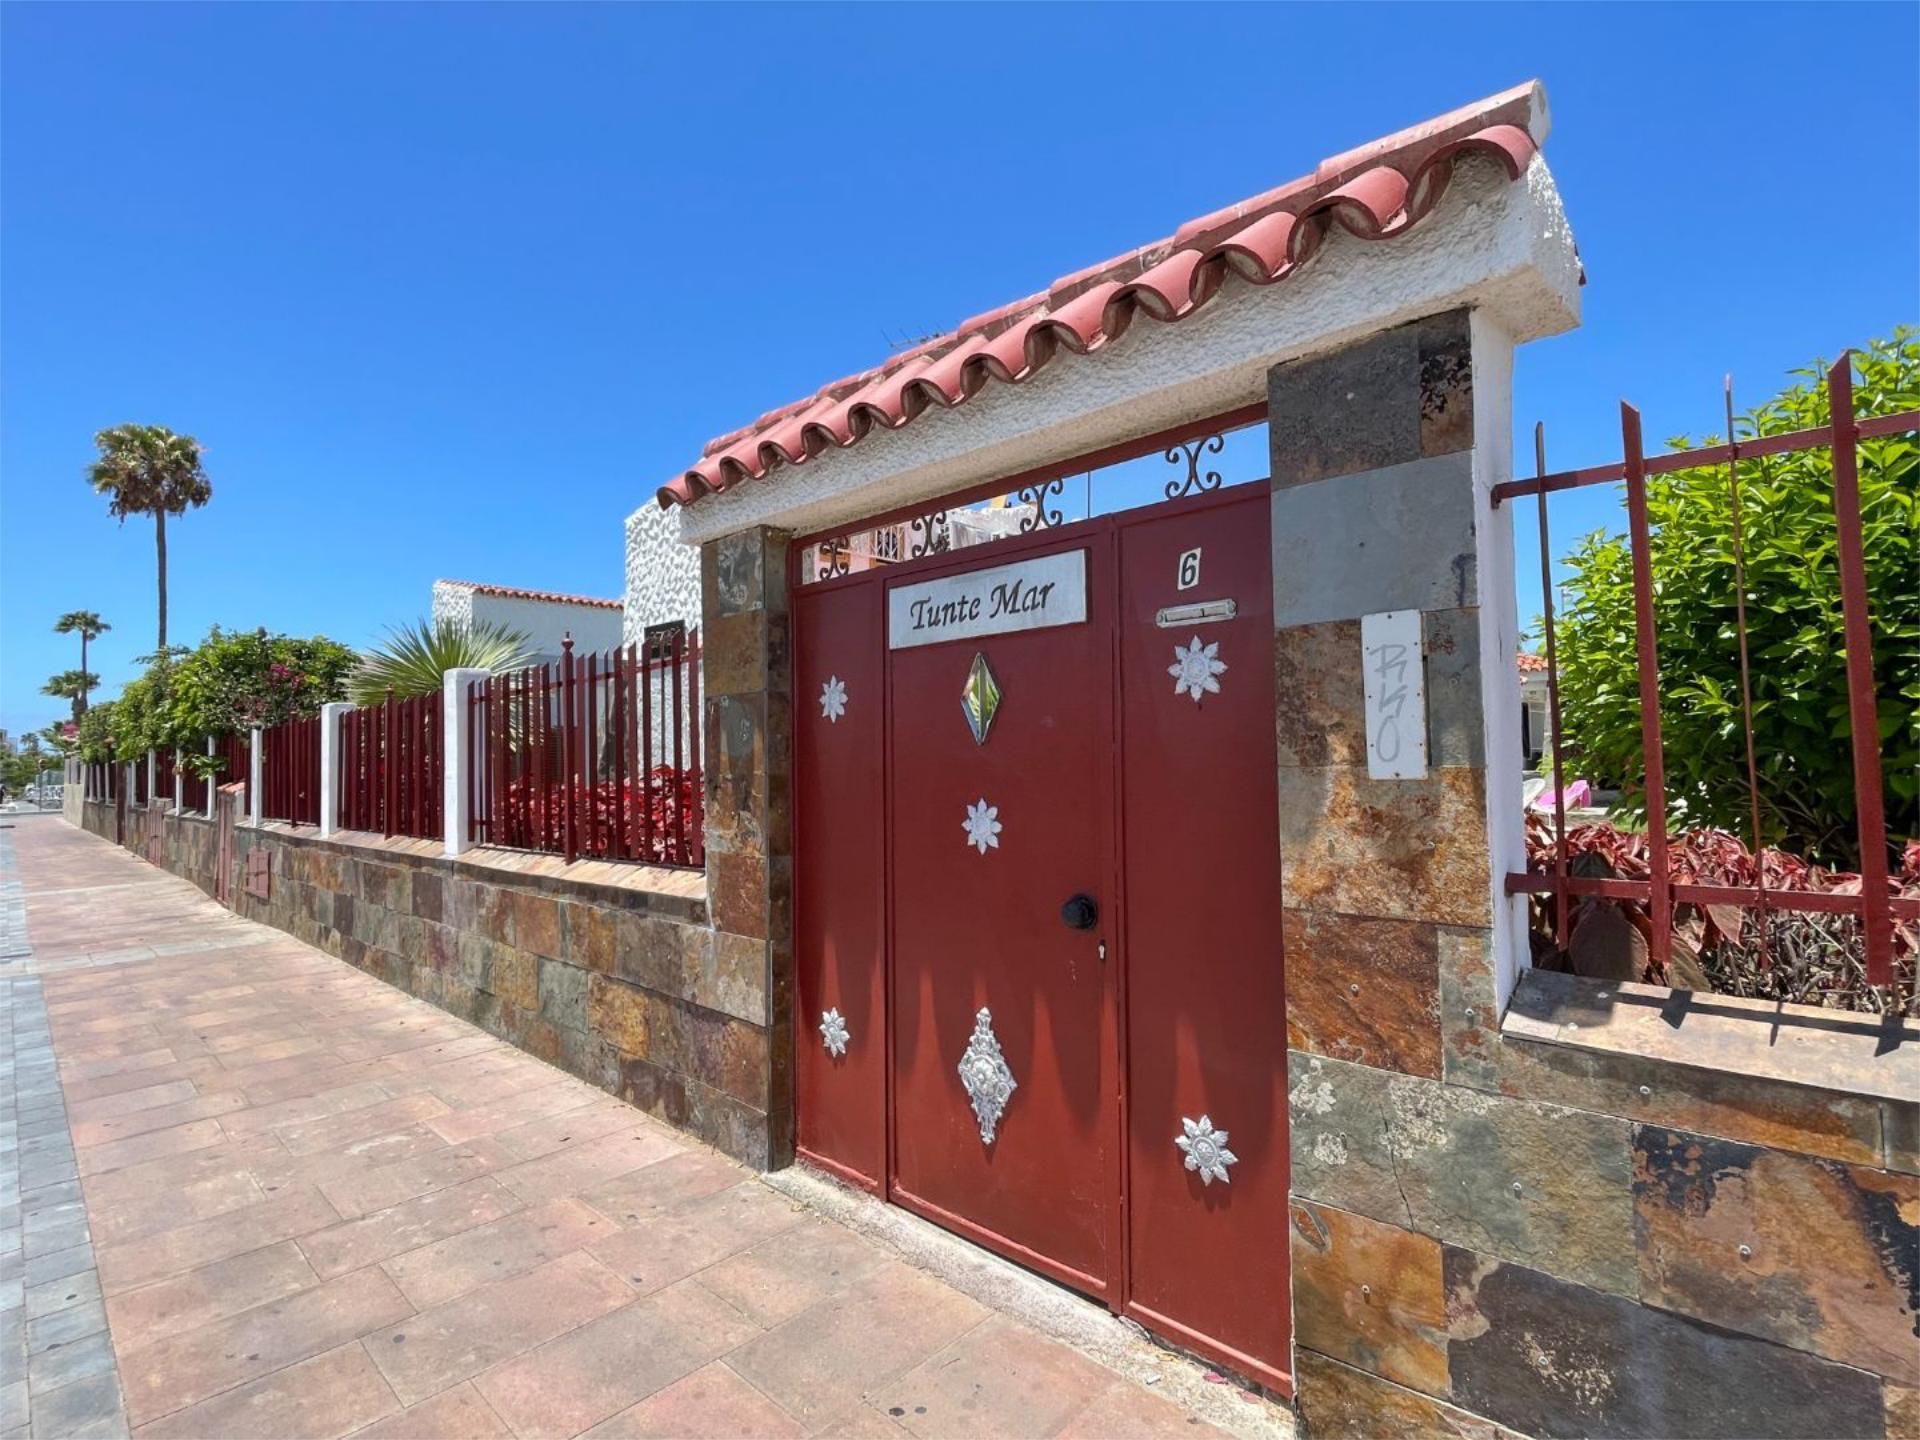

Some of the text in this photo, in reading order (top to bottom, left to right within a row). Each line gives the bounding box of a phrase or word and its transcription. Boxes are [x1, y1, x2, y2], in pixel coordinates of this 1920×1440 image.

[1181, 552, 1198, 586] 6
[910, 578, 1055, 630] Tunte Mar
